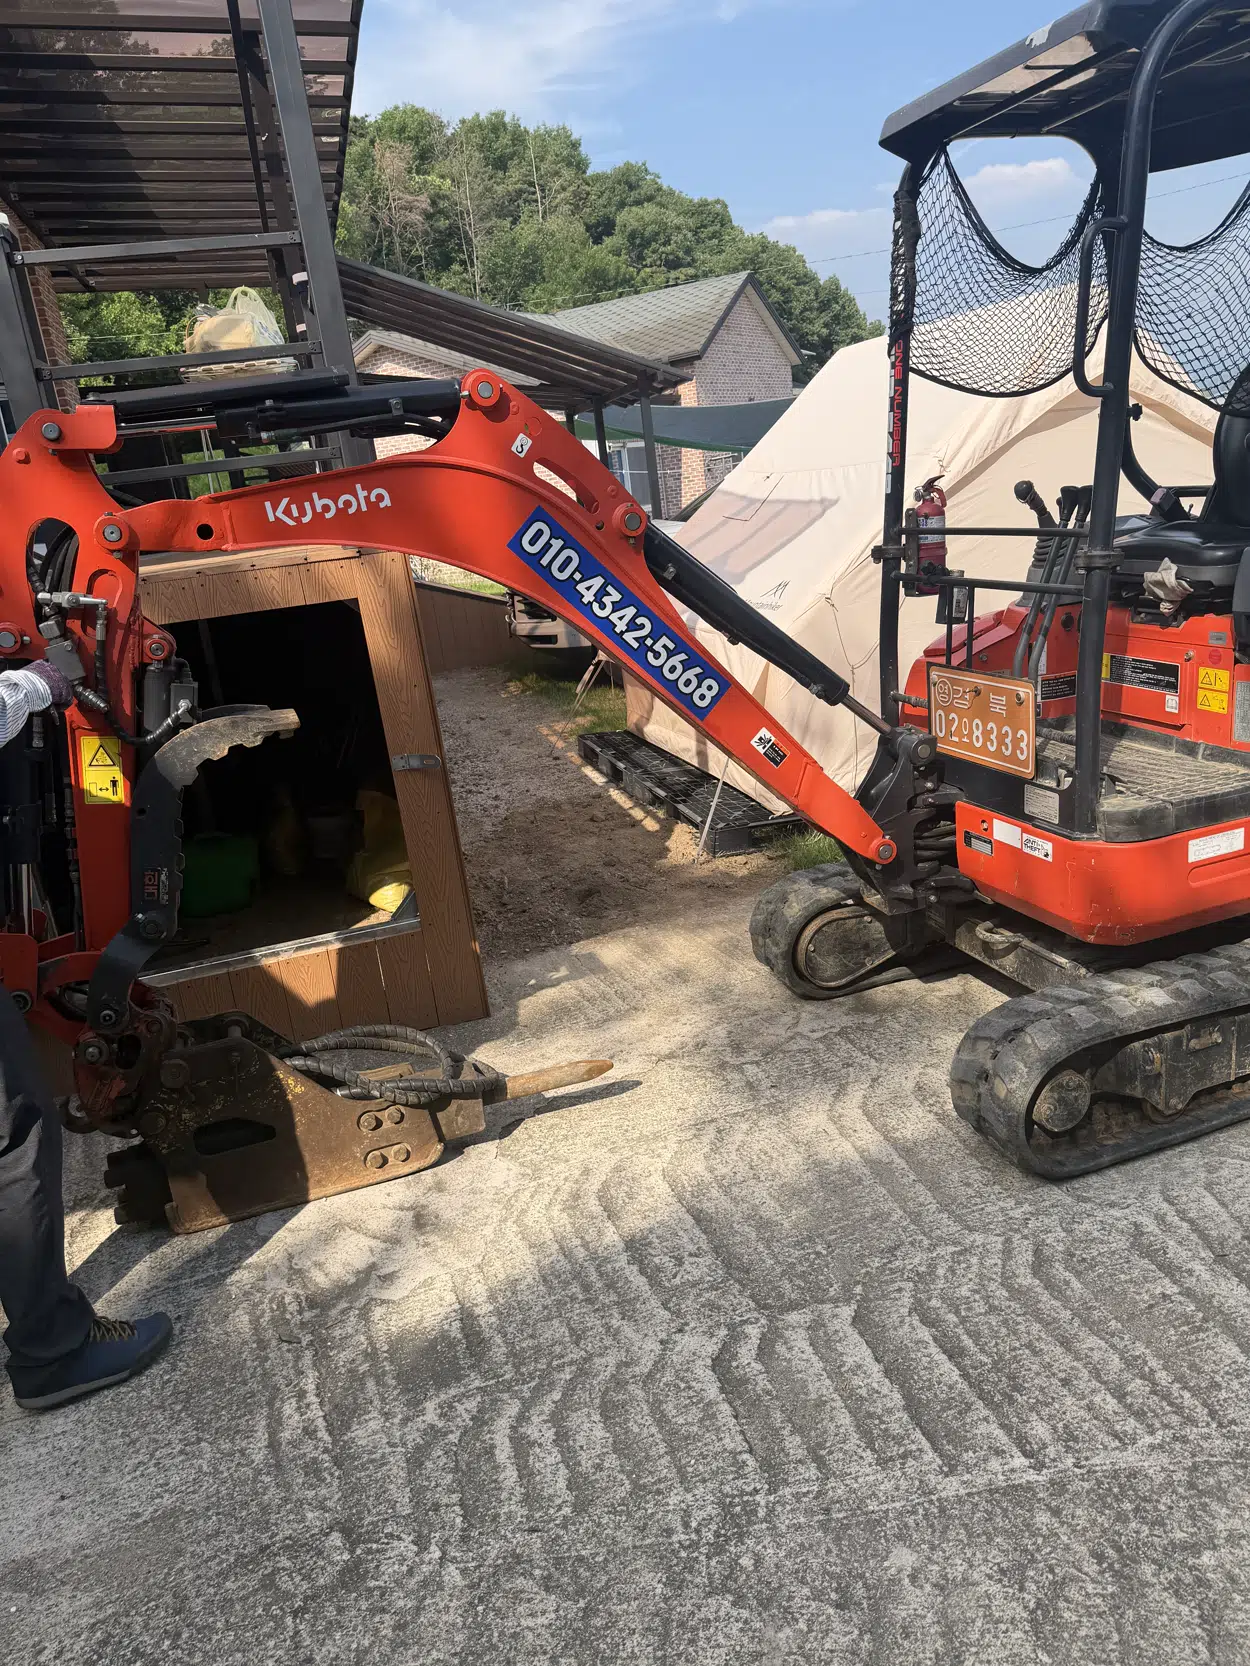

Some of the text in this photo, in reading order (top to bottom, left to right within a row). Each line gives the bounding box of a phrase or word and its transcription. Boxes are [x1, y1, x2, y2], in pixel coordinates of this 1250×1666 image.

[892, 386, 903, 467] NUMBER
[264, 483, 392, 526] Kubota
[520, 520, 720, 709] 010-4342-5668
[935, 709, 1028, 761] 02오8333
